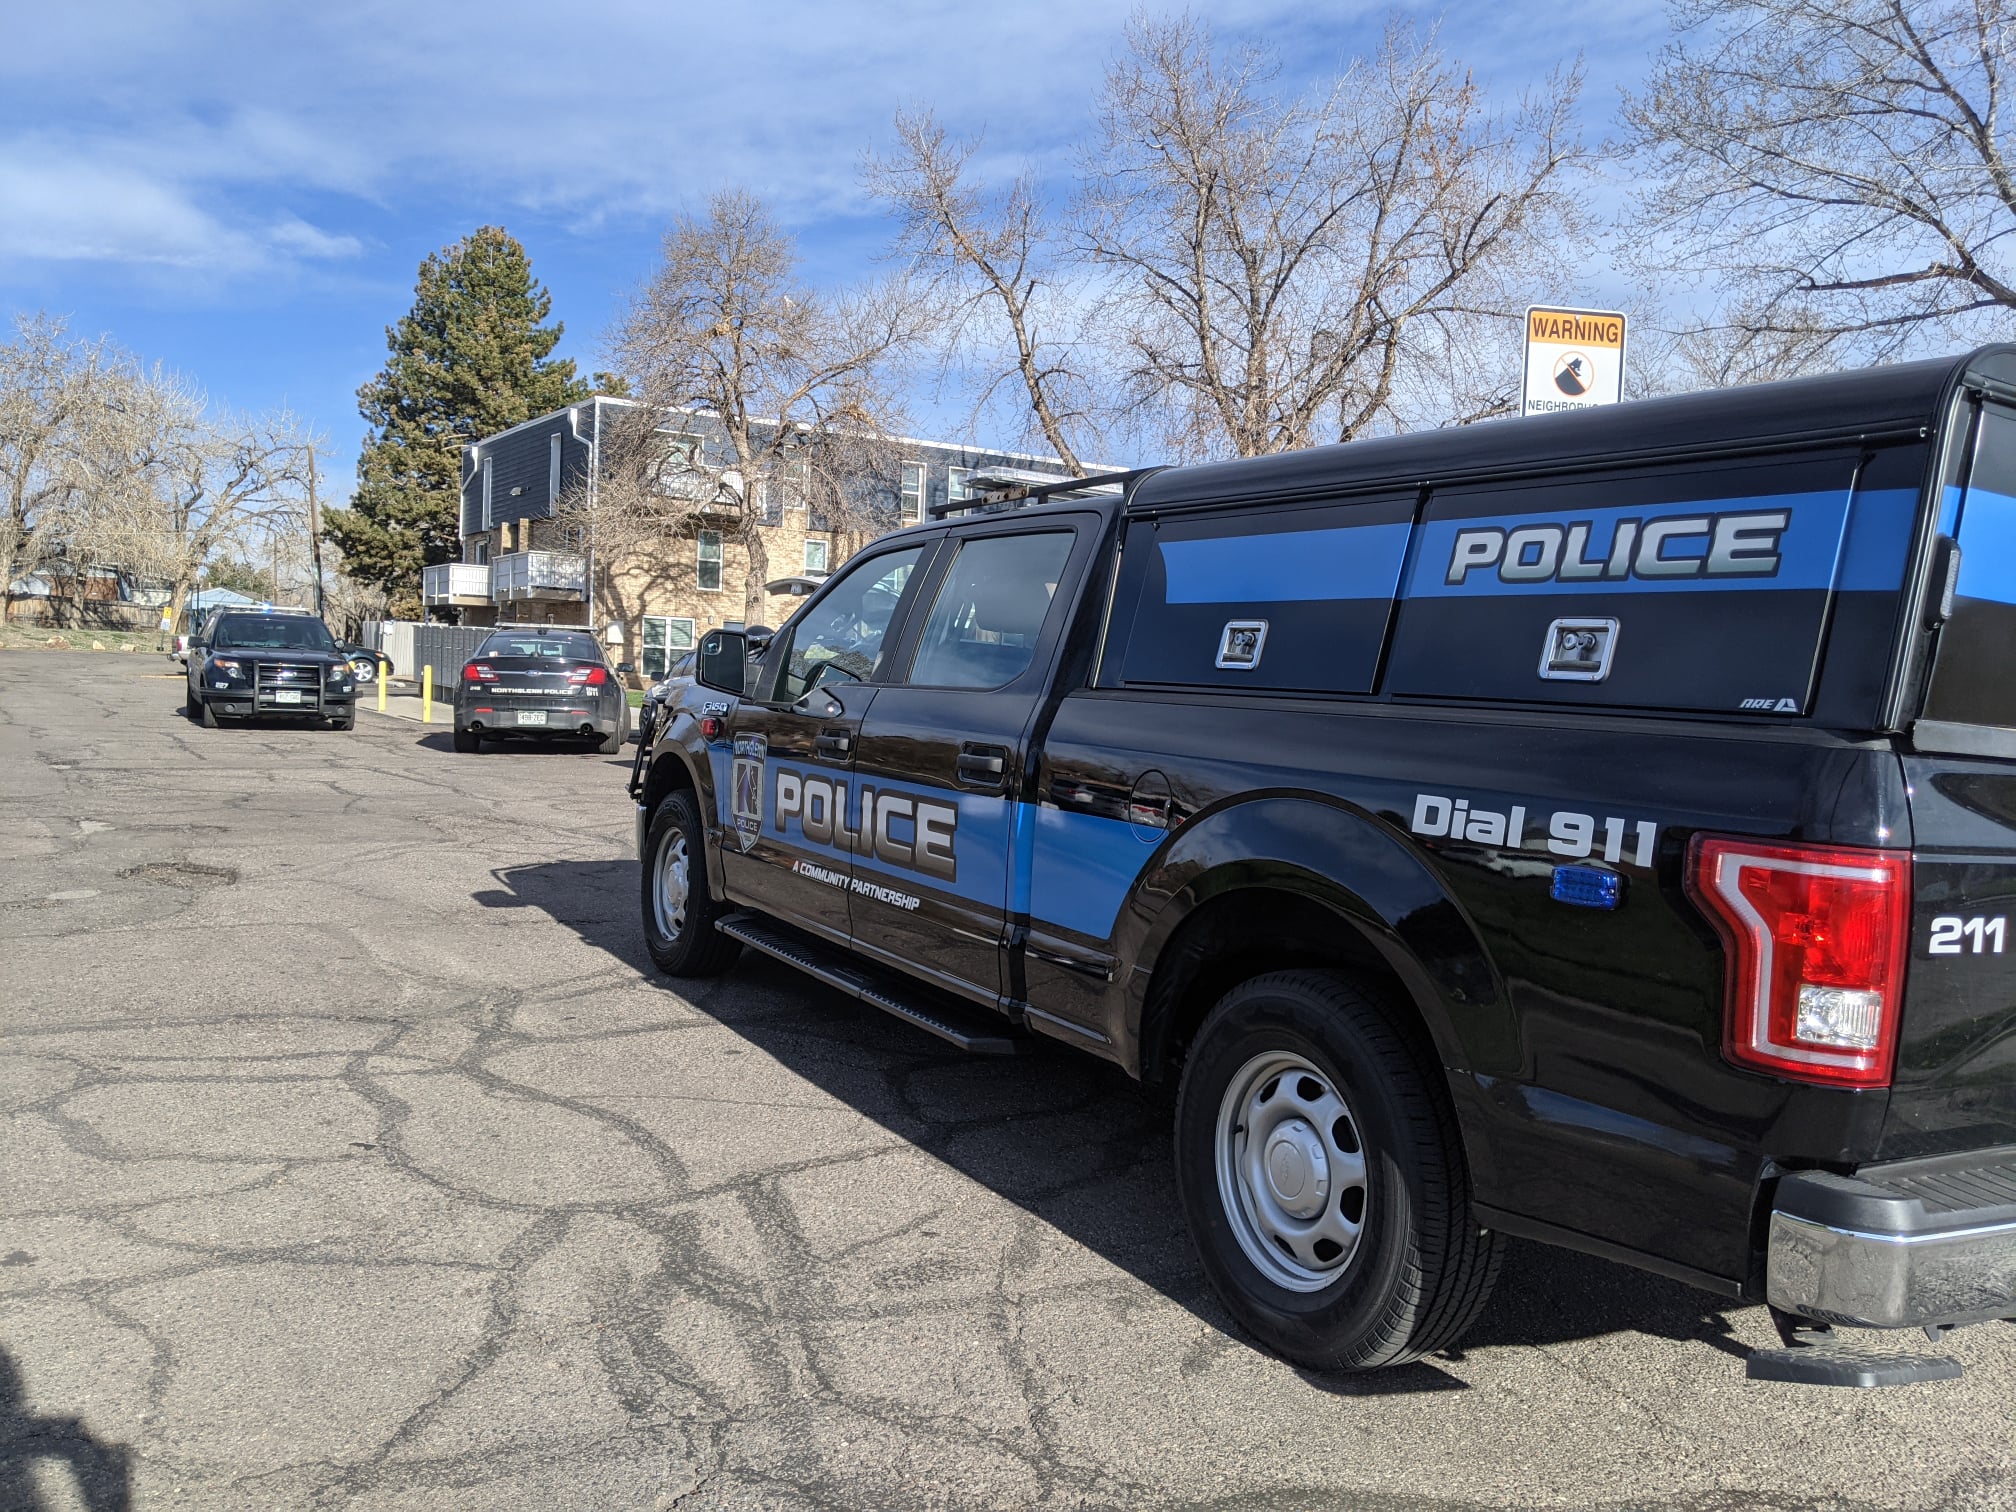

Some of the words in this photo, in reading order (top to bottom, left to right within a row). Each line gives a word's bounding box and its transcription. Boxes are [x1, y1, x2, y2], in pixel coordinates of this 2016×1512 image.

[1532, 317, 1619, 343] WARNING
[1445, 508, 1791, 585] POLICE
[736, 818, 758, 832] POLICE
[775, 767, 958, 883] POLICE
[1411, 794, 1526, 849] Dial
[1547, 811, 1658, 868] 911
[792, 860, 801, 874] A
[800, 862, 851, 889] COMMUNITY
[850, 878, 920, 911] PARTNERSHIP
[1928, 917, 2005, 955] 211
